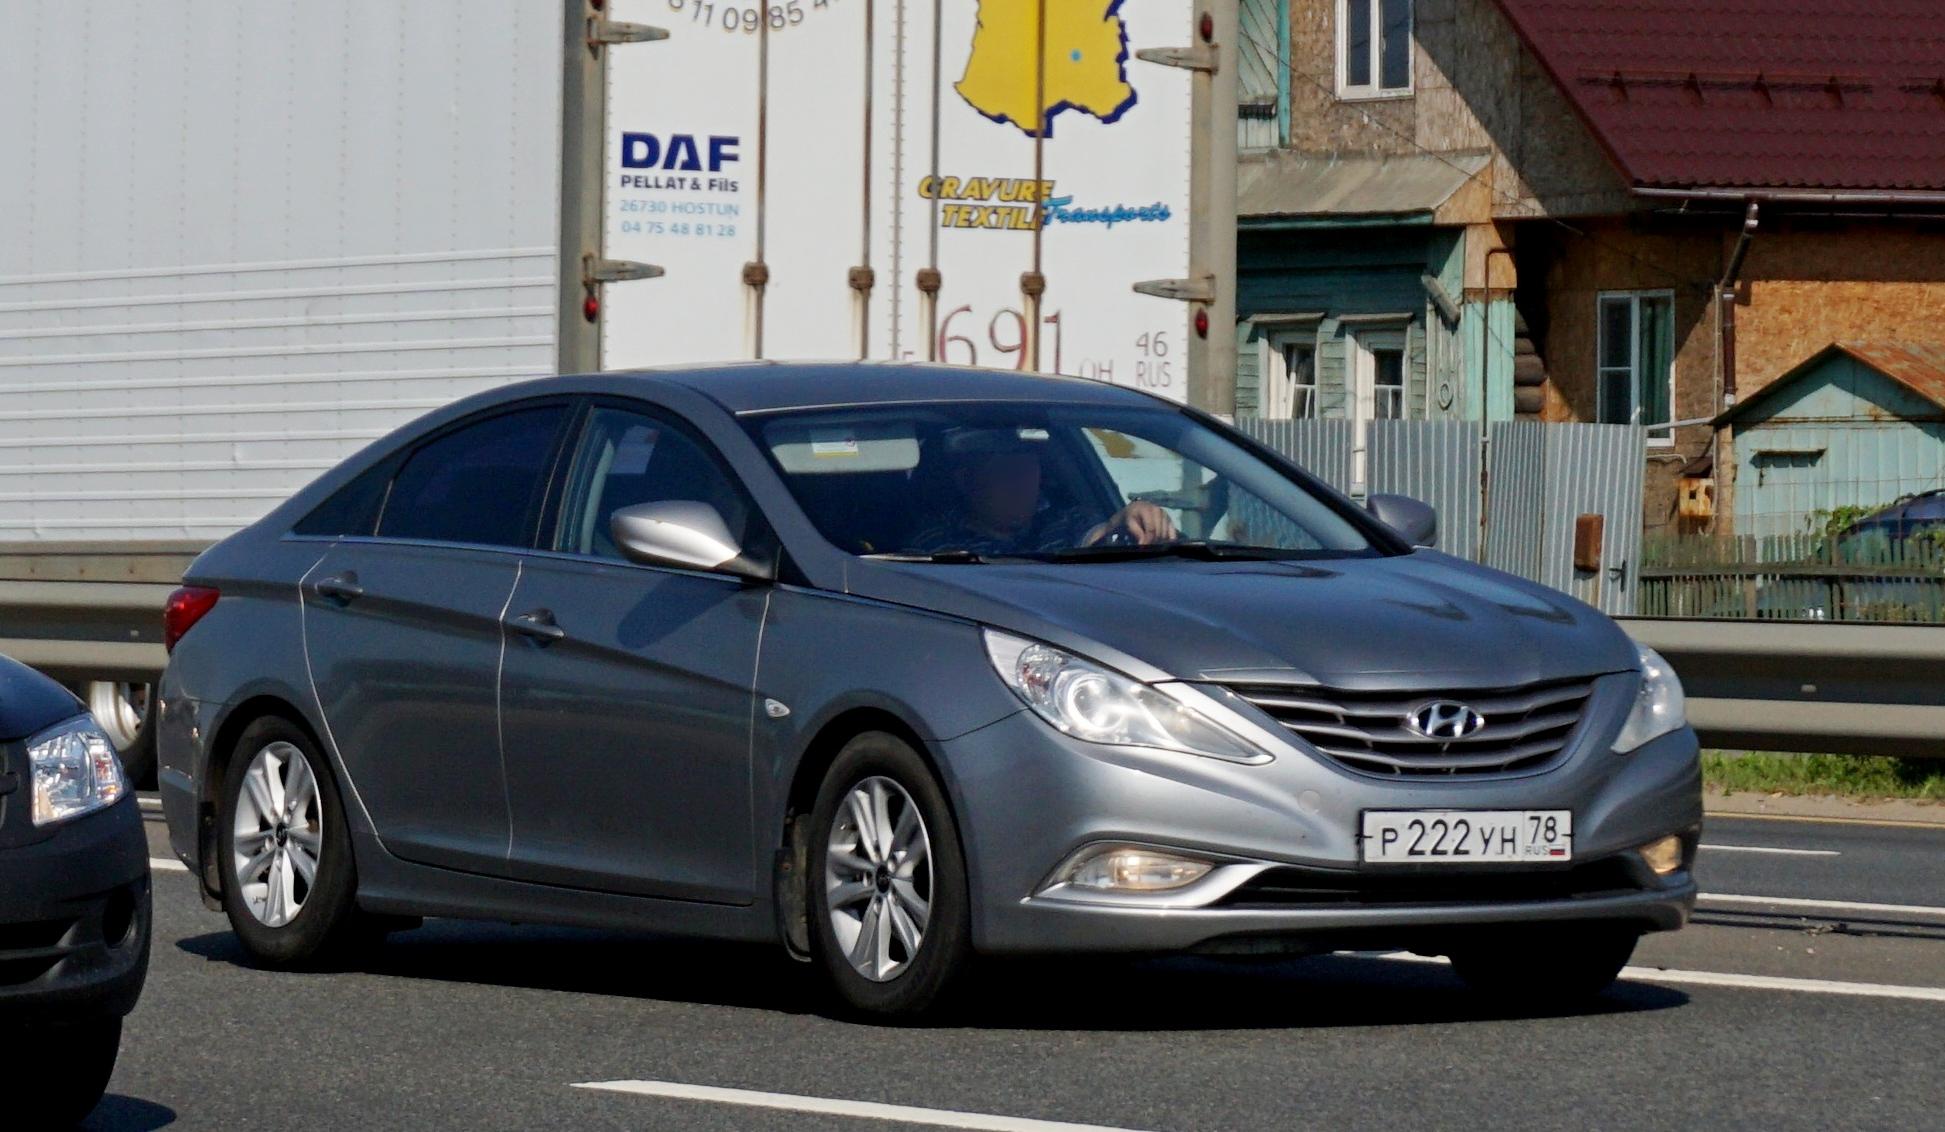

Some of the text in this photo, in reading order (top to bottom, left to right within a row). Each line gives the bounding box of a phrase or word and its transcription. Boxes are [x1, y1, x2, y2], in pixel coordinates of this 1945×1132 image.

[621, 131, 740, 172] DAF
[620, 174, 738, 192] PELLAT & Fils
[918, 175, 1056, 202] GRAVURE
[620, 200, 739, 216] 26730 HOSTUN
[1135, 331, 1169, 357] 46
[1136, 361, 1172, 388] RUS
[1529, 815, 1558, 844] 78
